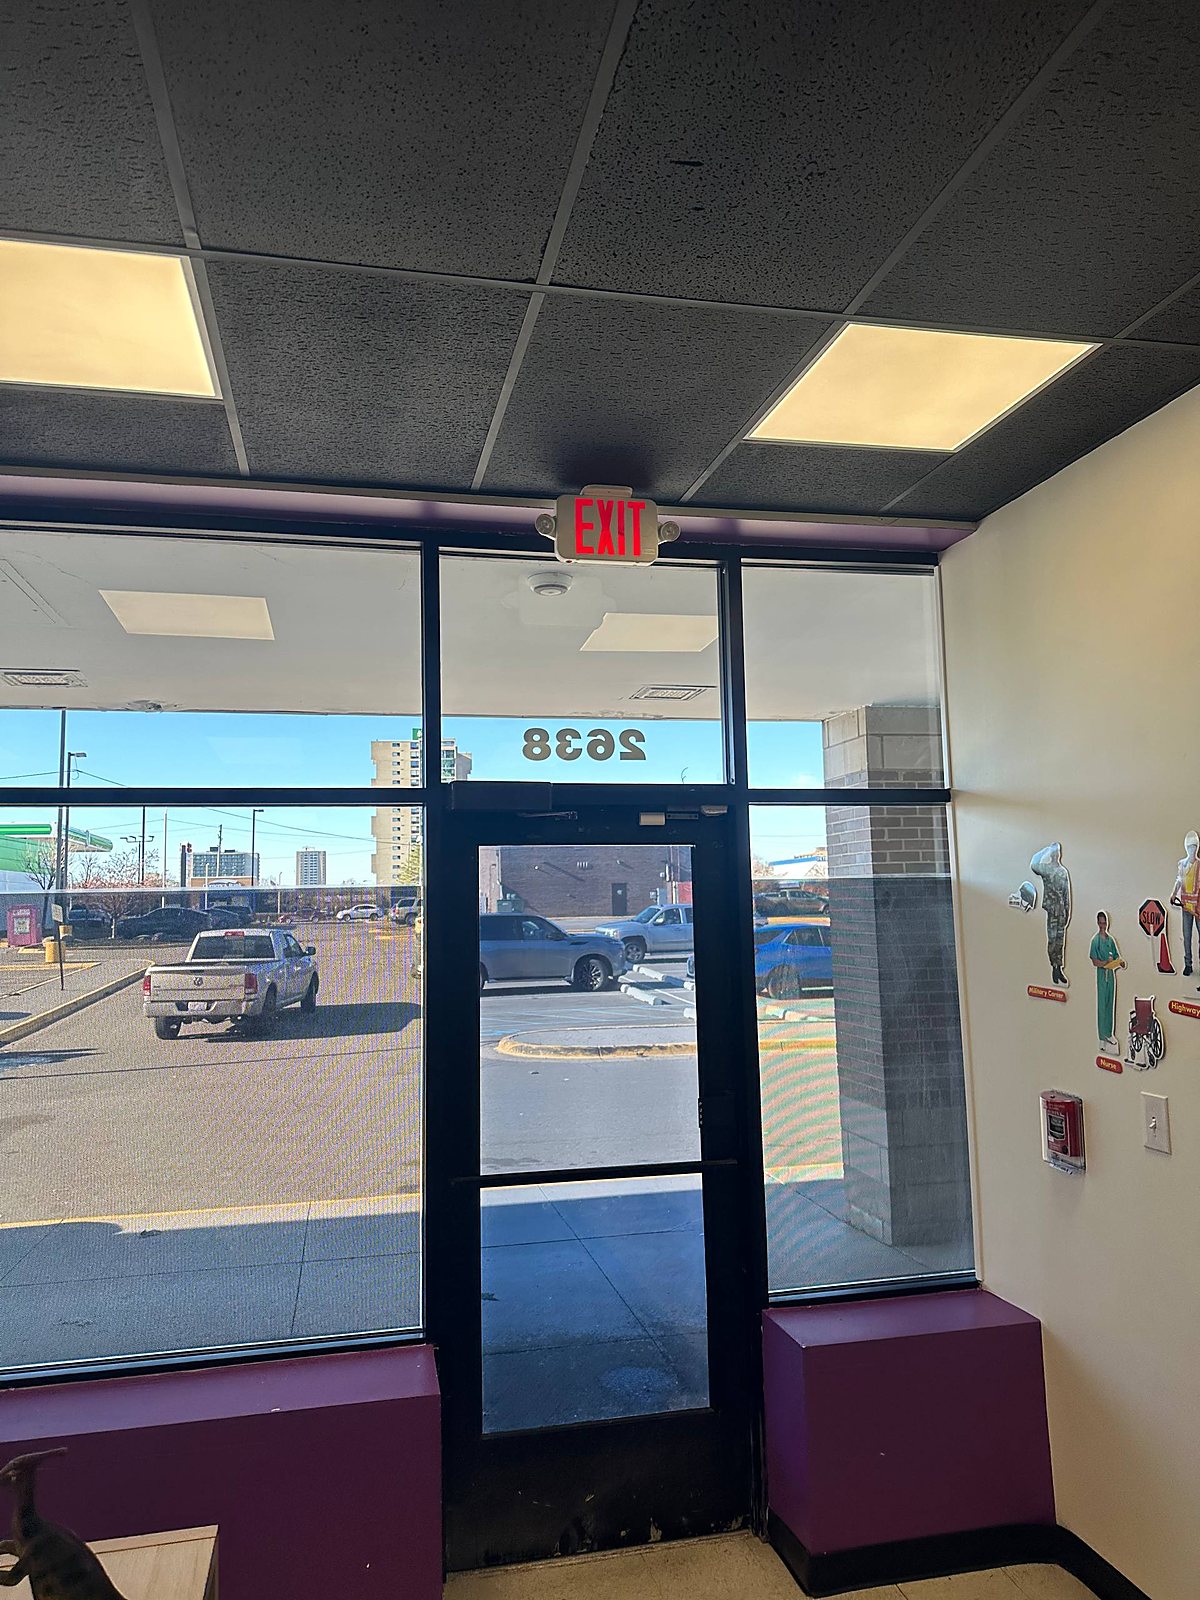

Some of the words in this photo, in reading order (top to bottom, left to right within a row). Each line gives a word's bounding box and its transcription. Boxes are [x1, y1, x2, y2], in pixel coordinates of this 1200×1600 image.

[574, 497, 646, 557] EXIT
[1142, 910, 1161, 925] SLOW
[1029, 986, 1048, 998] Military
[1171, 1001, 1200, 1017] Highway
[1100, 1058, 1117, 1071] Nurse
